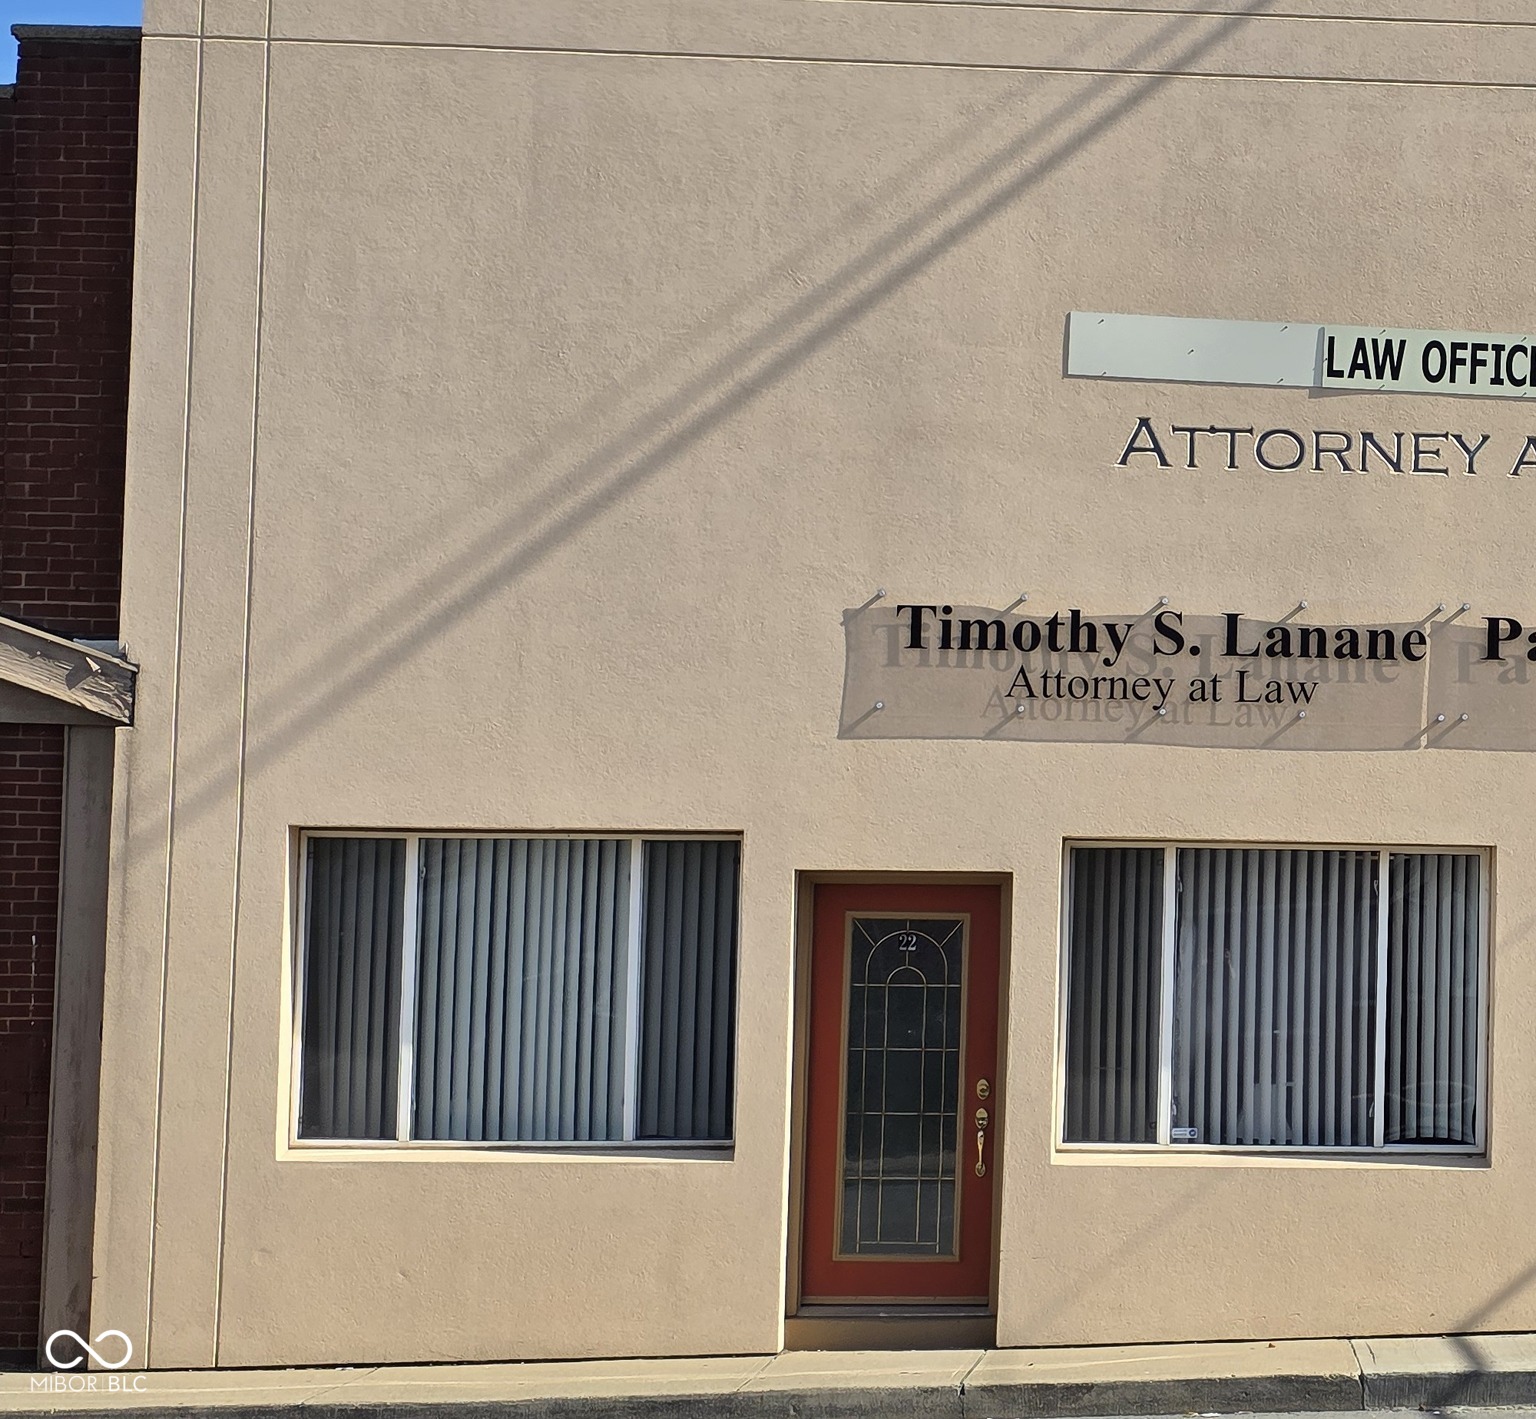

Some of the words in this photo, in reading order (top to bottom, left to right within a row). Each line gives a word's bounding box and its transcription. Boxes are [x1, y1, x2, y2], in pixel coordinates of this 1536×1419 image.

[1326, 335, 1407, 380] LAW
[897, 604, 1132, 666] Timothy
[1152, 610, 1201, 656] S.
[1221, 612, 1427, 662] Lanane
[1004, 665, 1174, 710] Attorney
[1188, 673, 1222, 702] at
[1235, 670, 1319, 705] Law
[899, 934, 917, 951] 22
